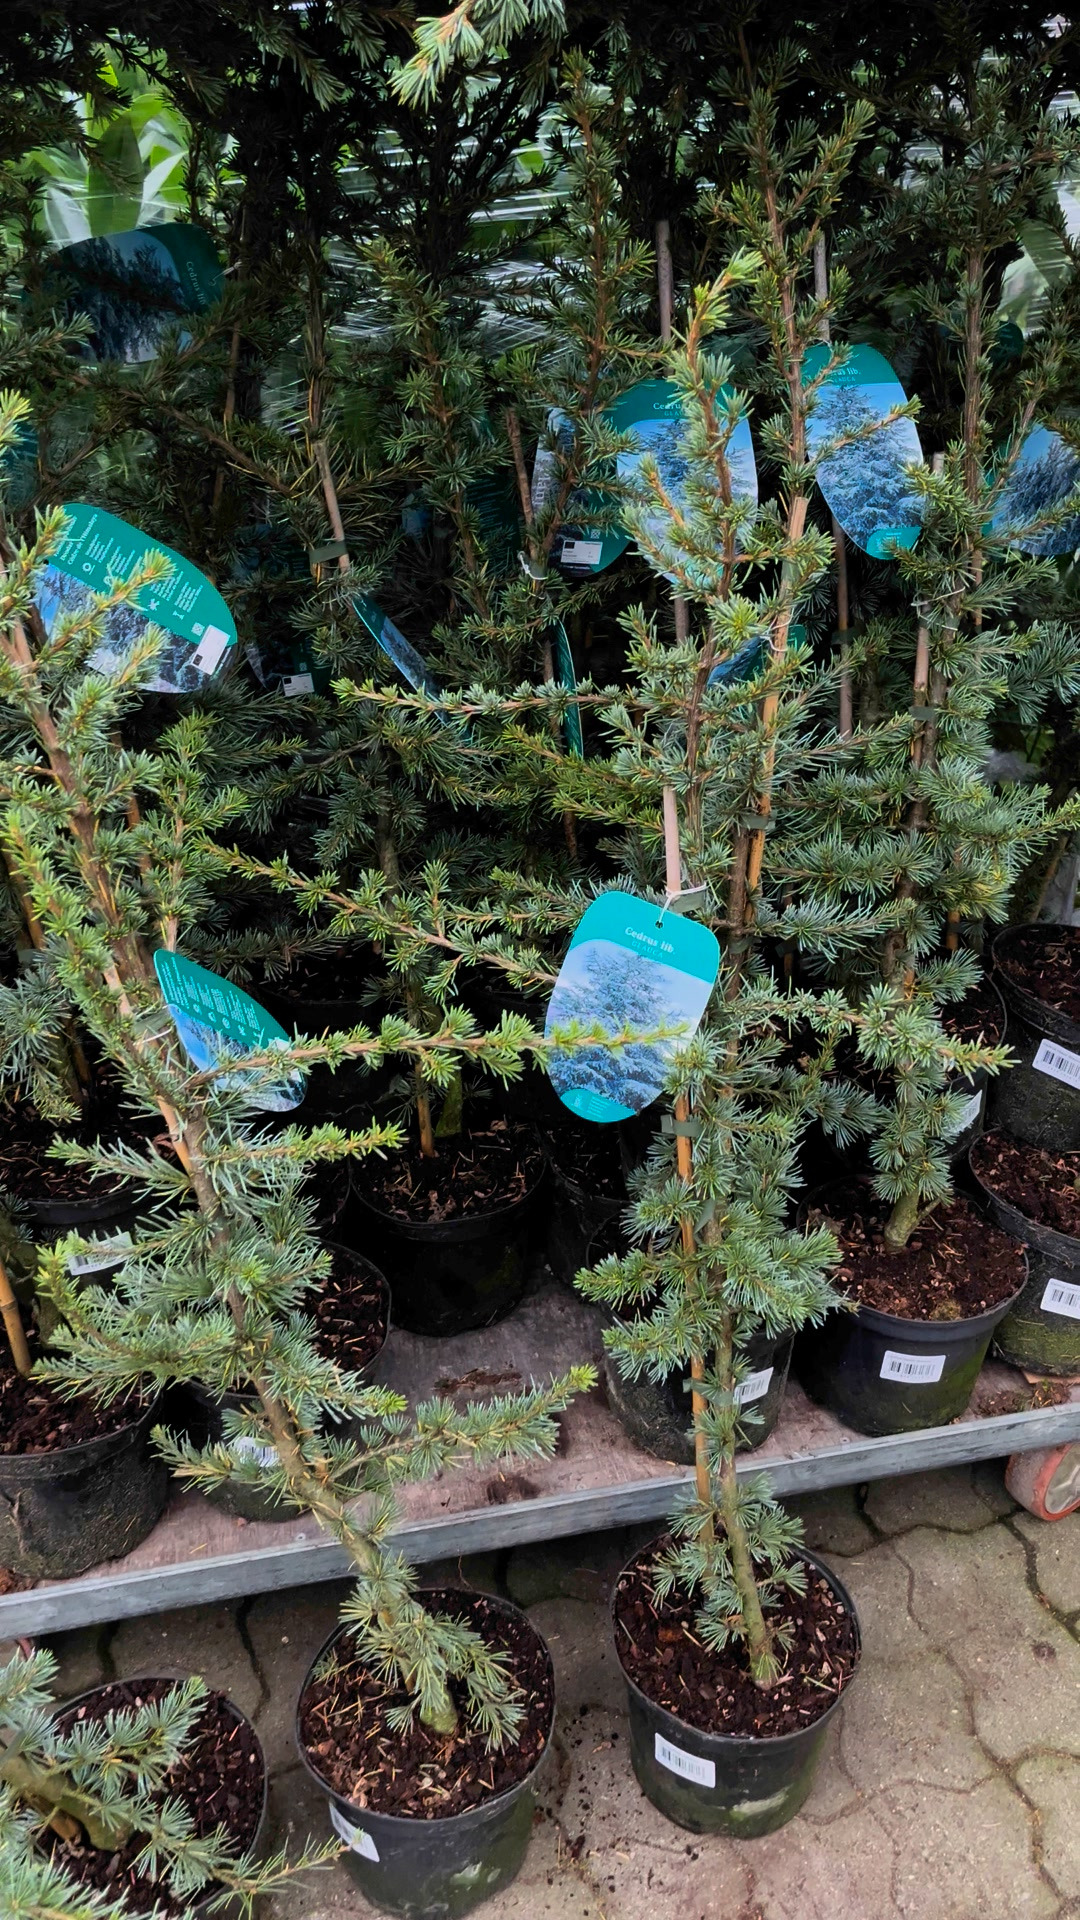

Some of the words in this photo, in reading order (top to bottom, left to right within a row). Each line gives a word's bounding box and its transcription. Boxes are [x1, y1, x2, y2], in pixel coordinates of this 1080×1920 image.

[186, 261, 200, 291] Cedrus
[625, 926, 659, 947] Cedrus
[631, 940, 664, 958] GLAUCA
